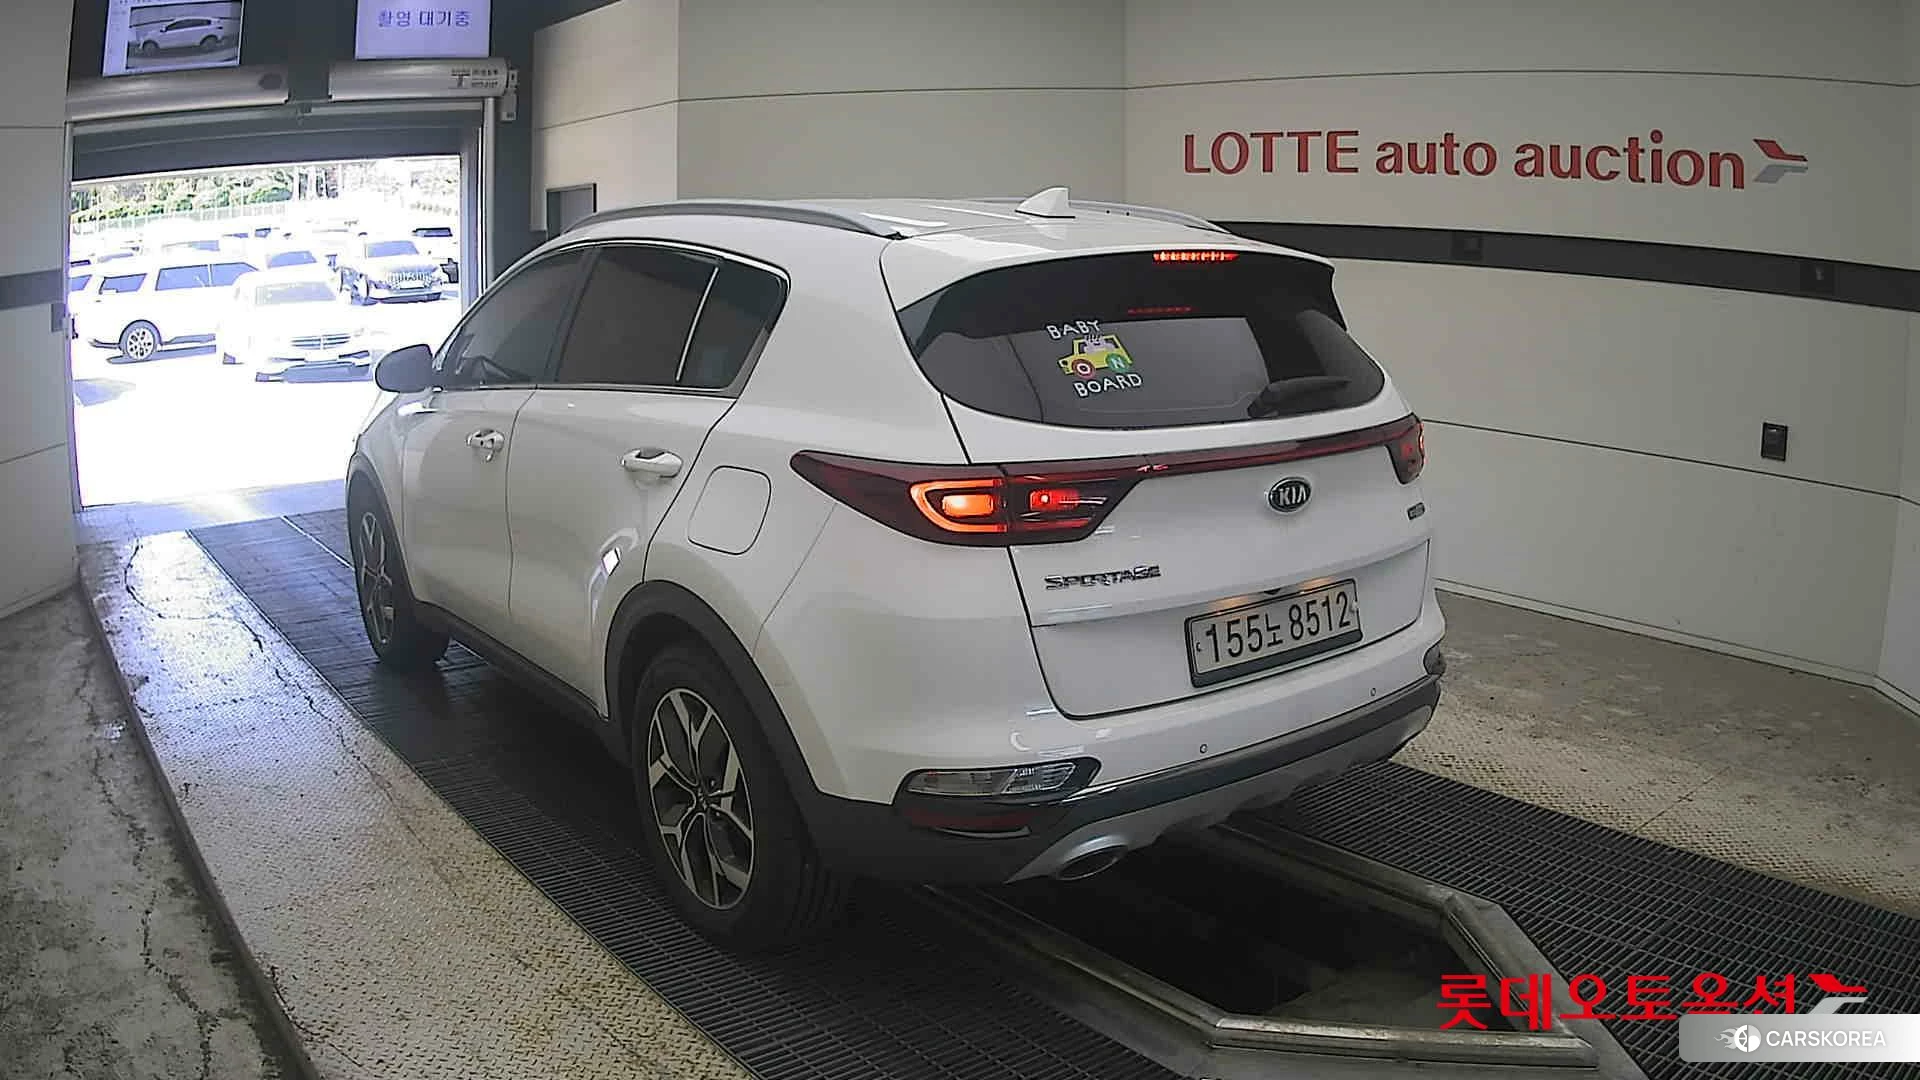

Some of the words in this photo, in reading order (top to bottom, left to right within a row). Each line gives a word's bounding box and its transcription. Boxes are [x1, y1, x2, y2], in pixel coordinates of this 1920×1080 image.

[419, 10, 470, 28] 대기중
[1184, 130, 1360, 174] LOTTE
[1375, 132, 1497, 177] auto
[1514, 129, 1745, 190] auction
[1046, 320, 1100, 339] BABY
[1073, 373, 1142, 397] BOARD
[1278, 486, 1307, 507] KIA
[1043, 565, 1161, 590] SPORTAGE
[1289, 591, 1351, 640] 8512
